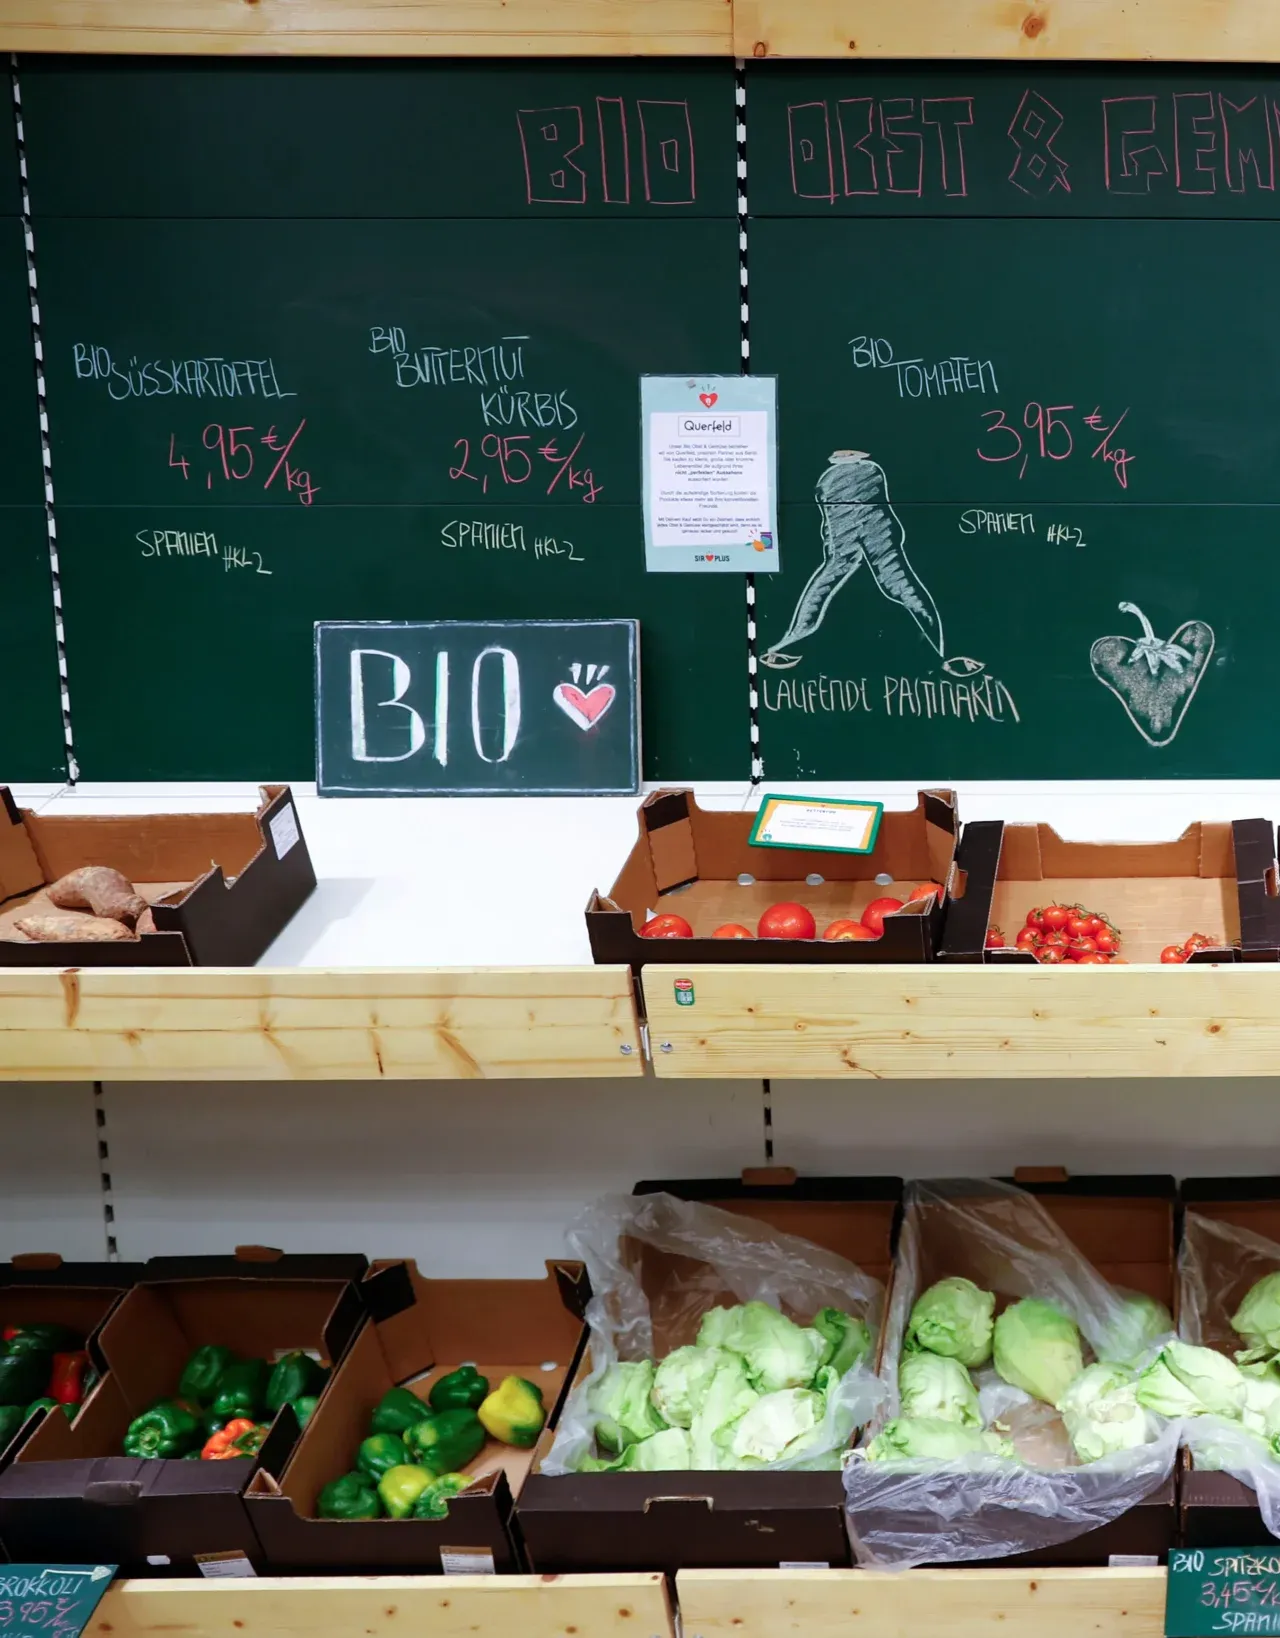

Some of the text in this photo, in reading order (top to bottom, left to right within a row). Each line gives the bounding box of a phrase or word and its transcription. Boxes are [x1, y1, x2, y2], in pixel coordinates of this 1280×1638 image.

[517, 97, 695, 204] BIO
[787, 96, 974, 204] OBST
[1007, 88, 1072, 197] &
[368, 326, 407, 354] BIO
[847, 335, 894, 368] BIO
[72, 342, 111, 380] BIO
[107, 355, 298, 401] SÜSSKARTOFFEL
[392, 336, 531, 388] BUTTERNUT
[879, 356, 999, 398] TOMATEN
[480, 384, 578, 430] KÜRBIS
[683, 419, 733, 433] Querfeld
[440, 519, 527, 551] SPANIEN
[958, 508, 1036, 535] SPANIEN
[135, 529, 219, 557] SPANIEN
[350, 646, 522, 768] BIO
[762, 670, 1021, 723] LAUFENDE PASTINAKEN
[1172, 1550, 1205, 1574] BIO
